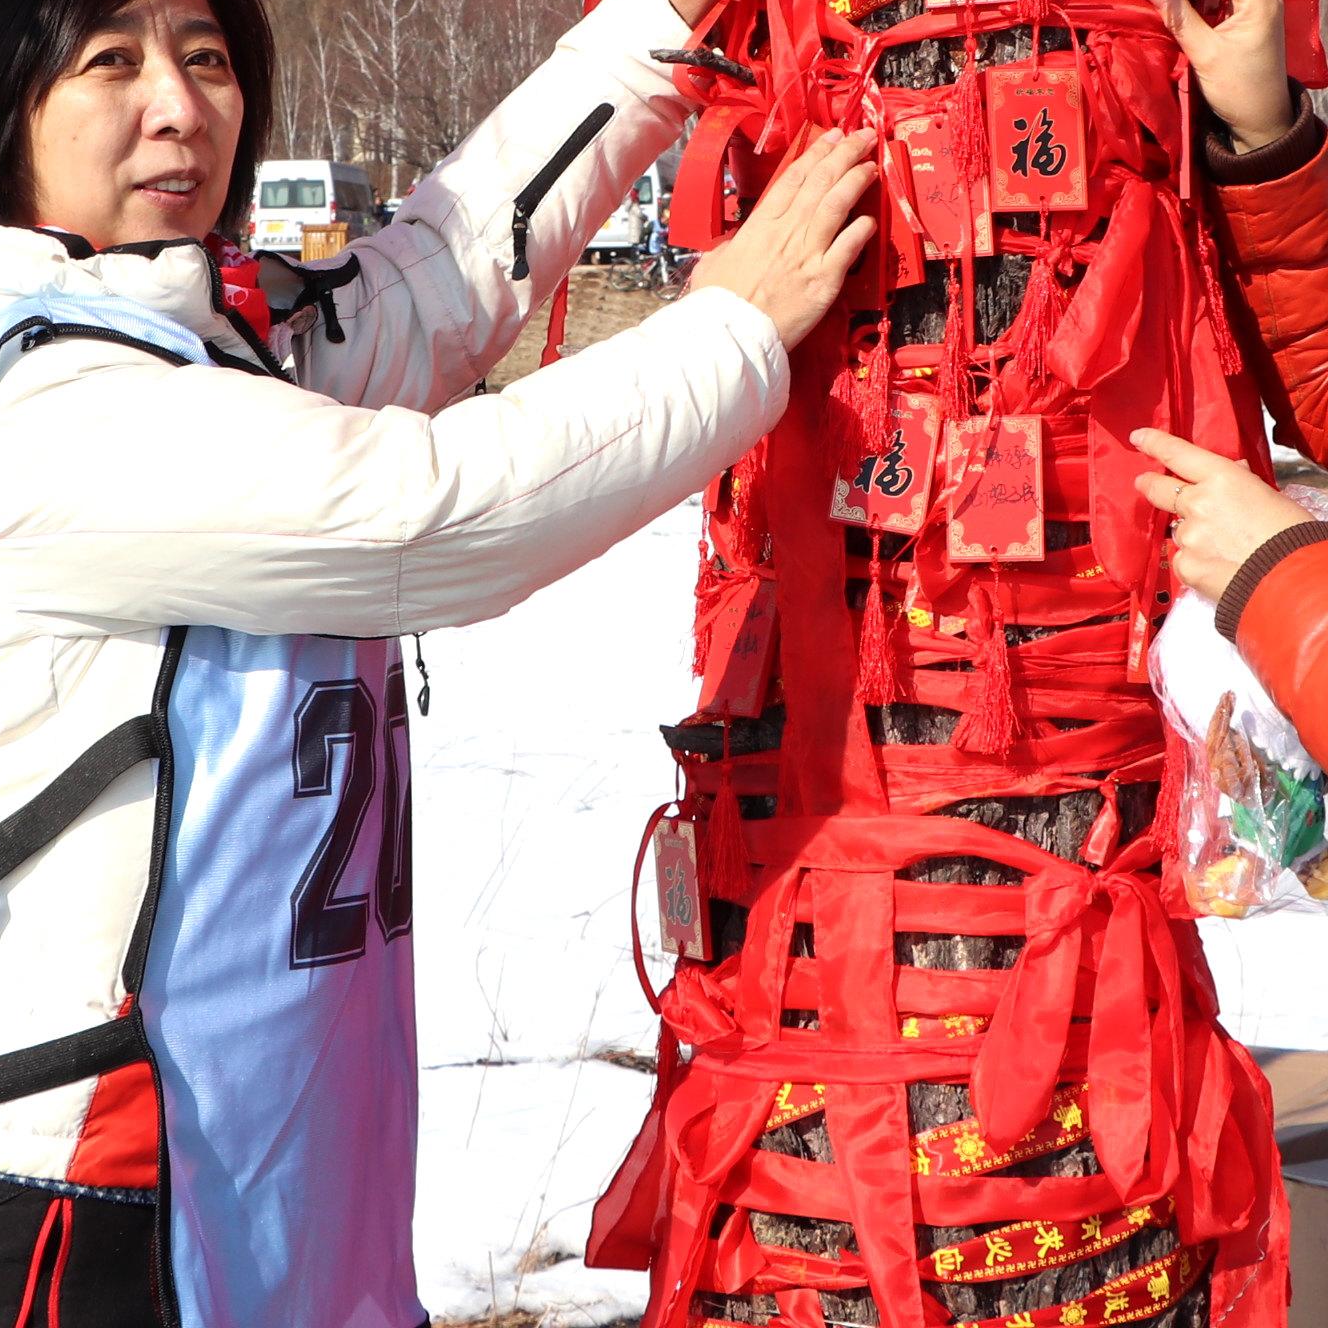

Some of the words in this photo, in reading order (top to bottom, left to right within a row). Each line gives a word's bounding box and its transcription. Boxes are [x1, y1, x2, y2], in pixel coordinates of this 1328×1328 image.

[1011, 106, 1067, 178] 福
[853, 429, 913, 496] 福
[289, 662, 414, 970] 20
[665, 864, 692, 927] 福
[934, 1213, 1103, 1278] 有求必应
